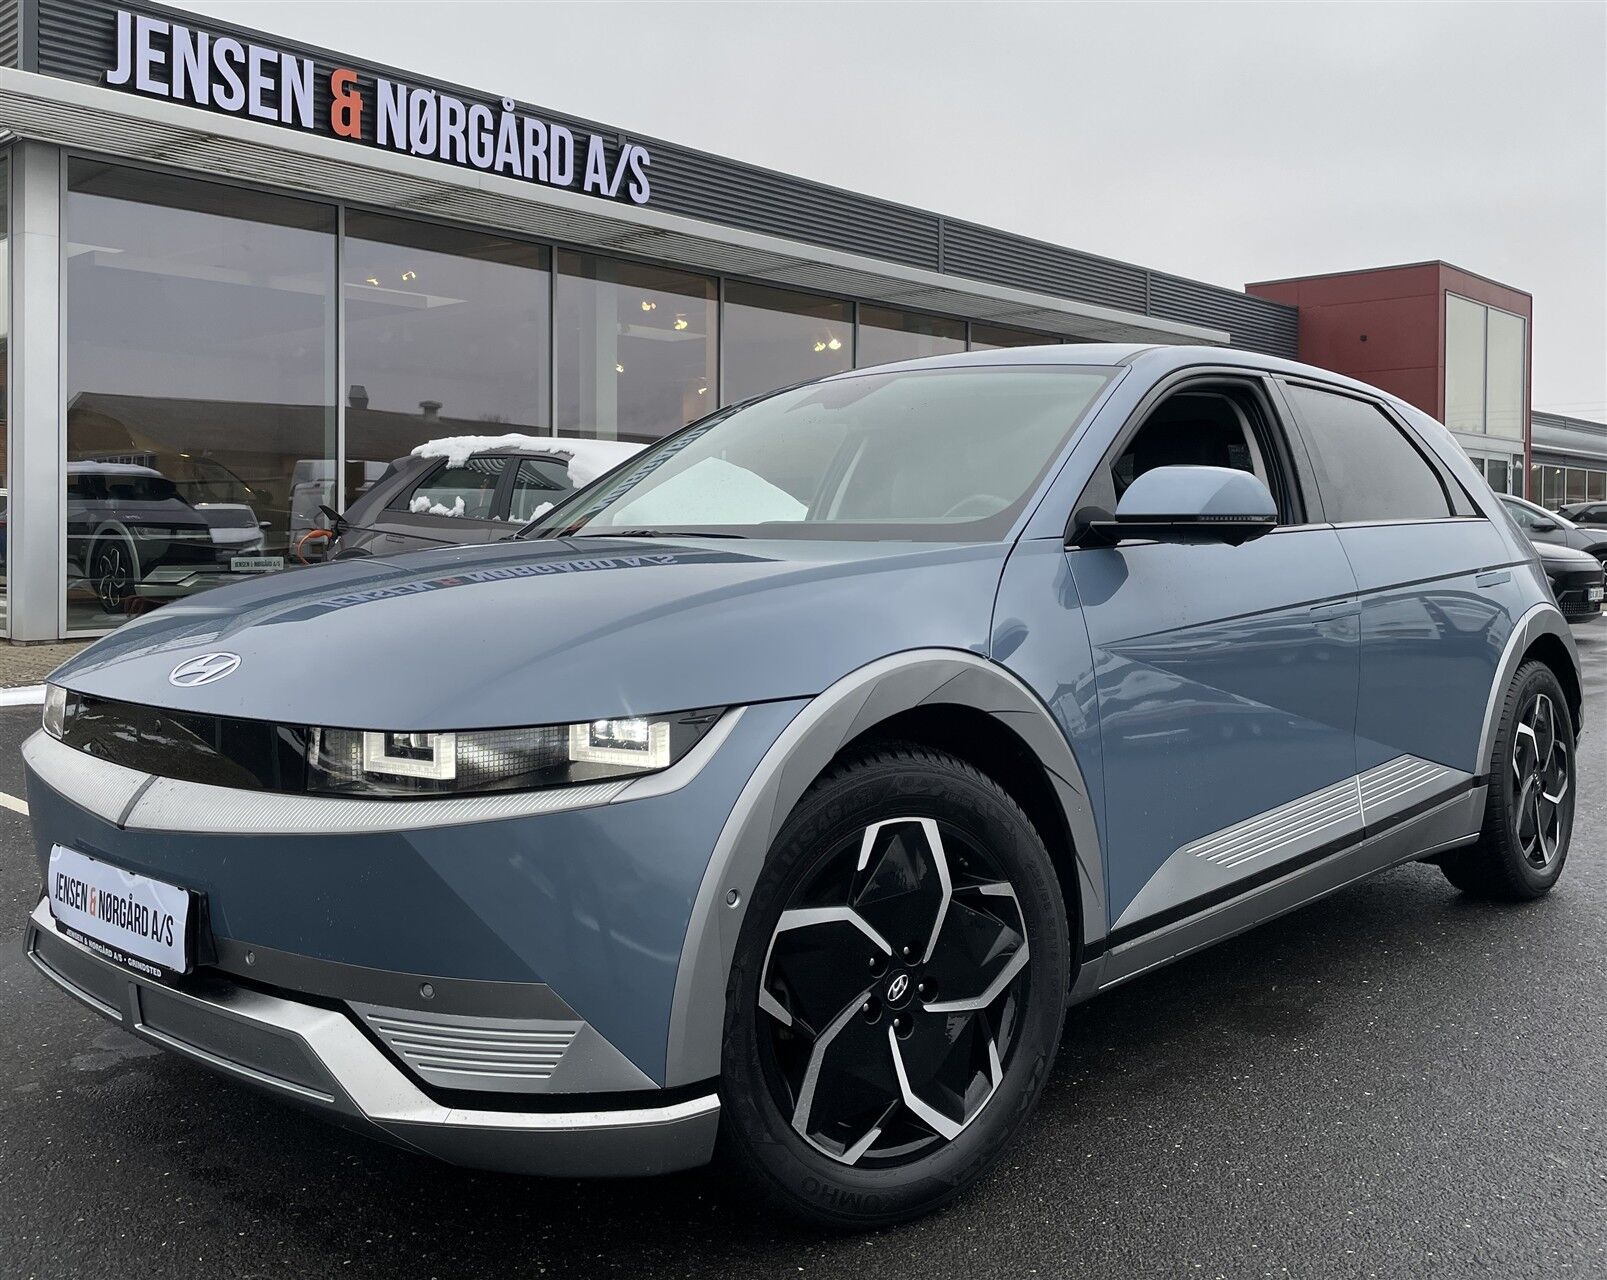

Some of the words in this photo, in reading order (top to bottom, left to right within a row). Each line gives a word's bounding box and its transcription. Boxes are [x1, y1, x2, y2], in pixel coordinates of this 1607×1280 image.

[106, 10, 315, 128] JENSEN
[330, 69, 364, 139] &
[376, 77, 575, 187] NØRGÅRD
[584, 134, 652, 204] A/S
[55, 872, 88, 912] JENSEN
[89, 886, 96, 917] &
[98, 891, 149, 936] NØRGÅRD
[151, 910, 174, 948] A/S
